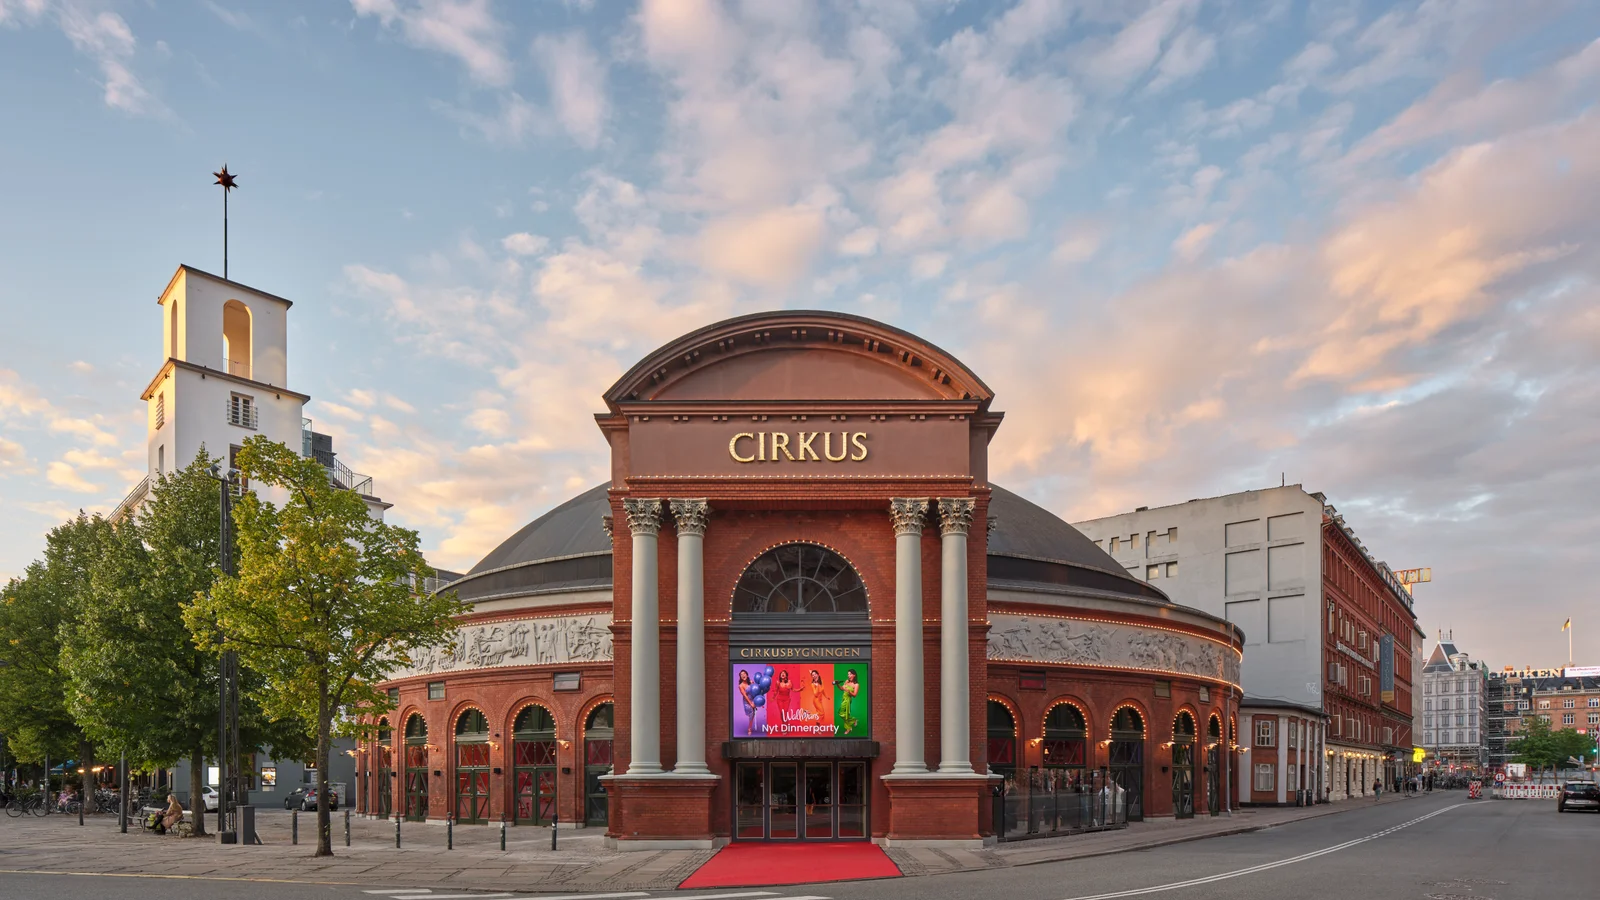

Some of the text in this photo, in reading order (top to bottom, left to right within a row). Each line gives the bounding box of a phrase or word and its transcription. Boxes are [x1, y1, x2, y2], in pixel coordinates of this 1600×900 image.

[728, 431, 868, 463] CIRKUS
[740, 647, 860, 658] CIRKUSBYGNINGEN
[761, 723, 840, 735] Nyt Dinnerparty
